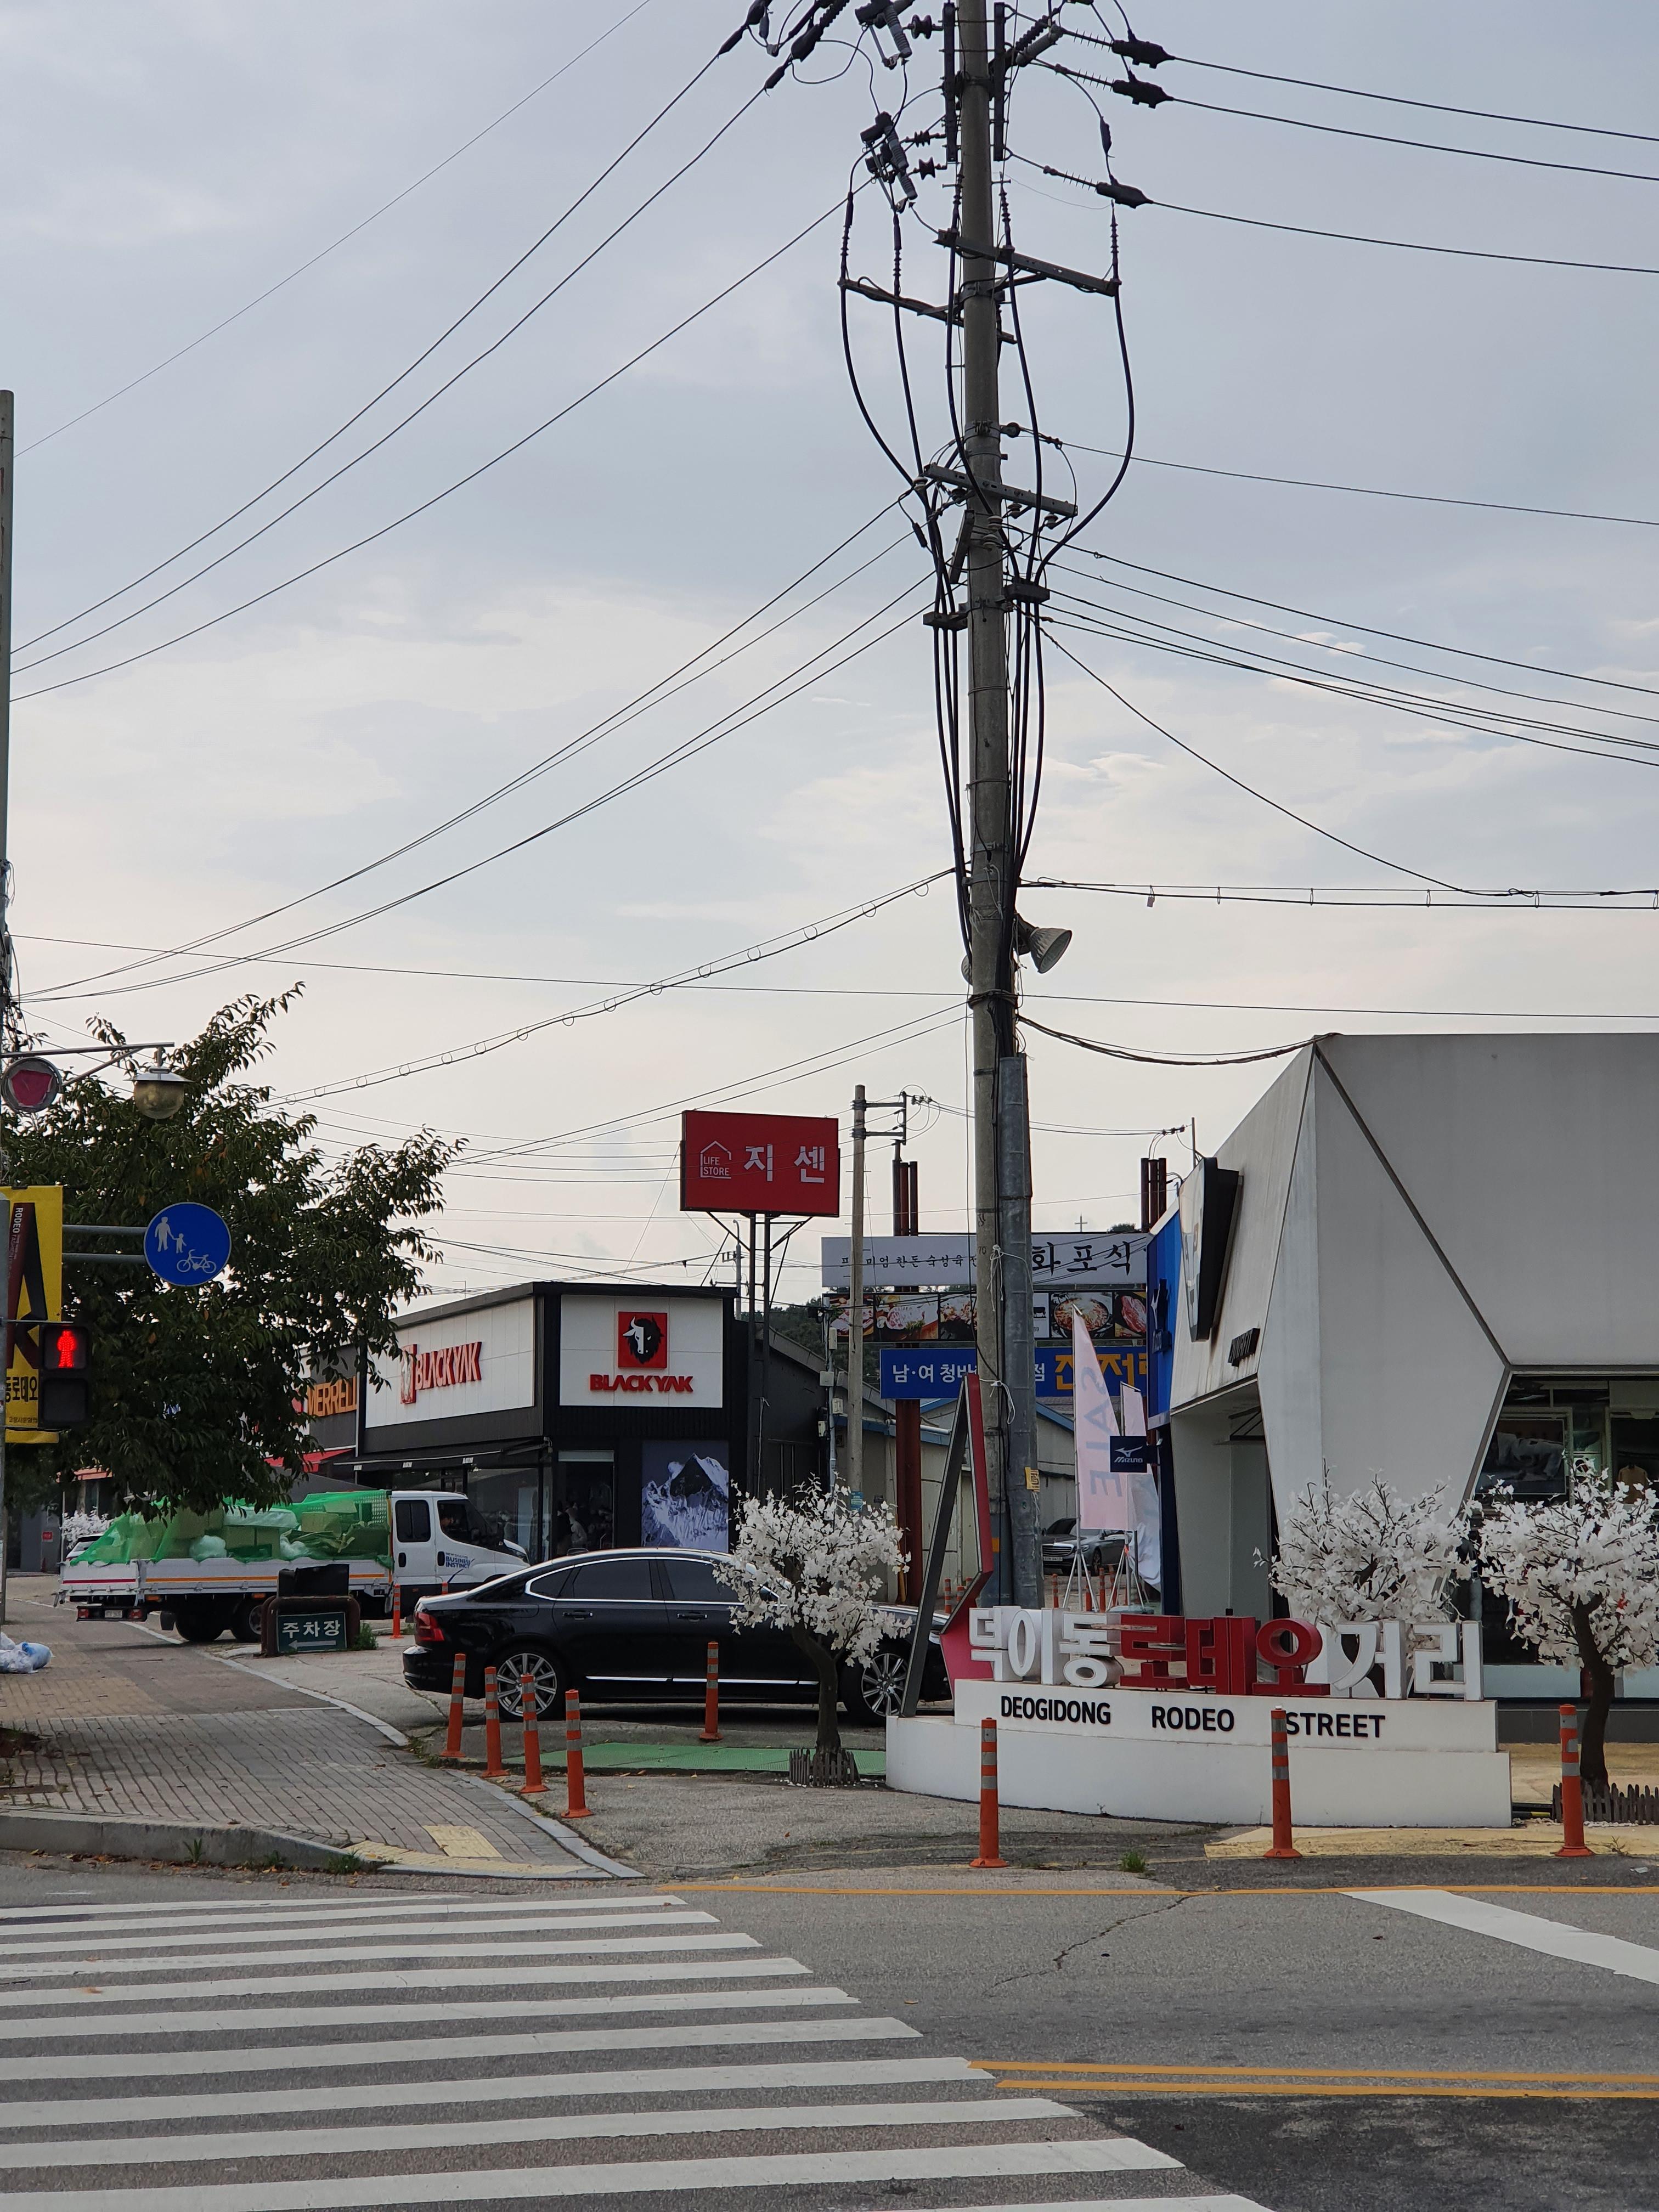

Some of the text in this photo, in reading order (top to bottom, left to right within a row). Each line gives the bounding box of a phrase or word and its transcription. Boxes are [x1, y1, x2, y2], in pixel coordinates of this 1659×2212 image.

[703, 1156, 720, 1165] LIFE
[703, 1166, 730, 1176] STORE
[12, 1207, 24, 1234] RODEO
[840, 1255, 889, 1268] 프미엄
[896, 1255, 919, 1269] 한돈
[940, 1364, 977, 1383] 청바
[445, 1556, 471, 1565] BUSINESS
[282, 1620, 341, 1639] 주차장
[1001, 1695, 1386, 1739] DEOGIDONG RODEO STREET
